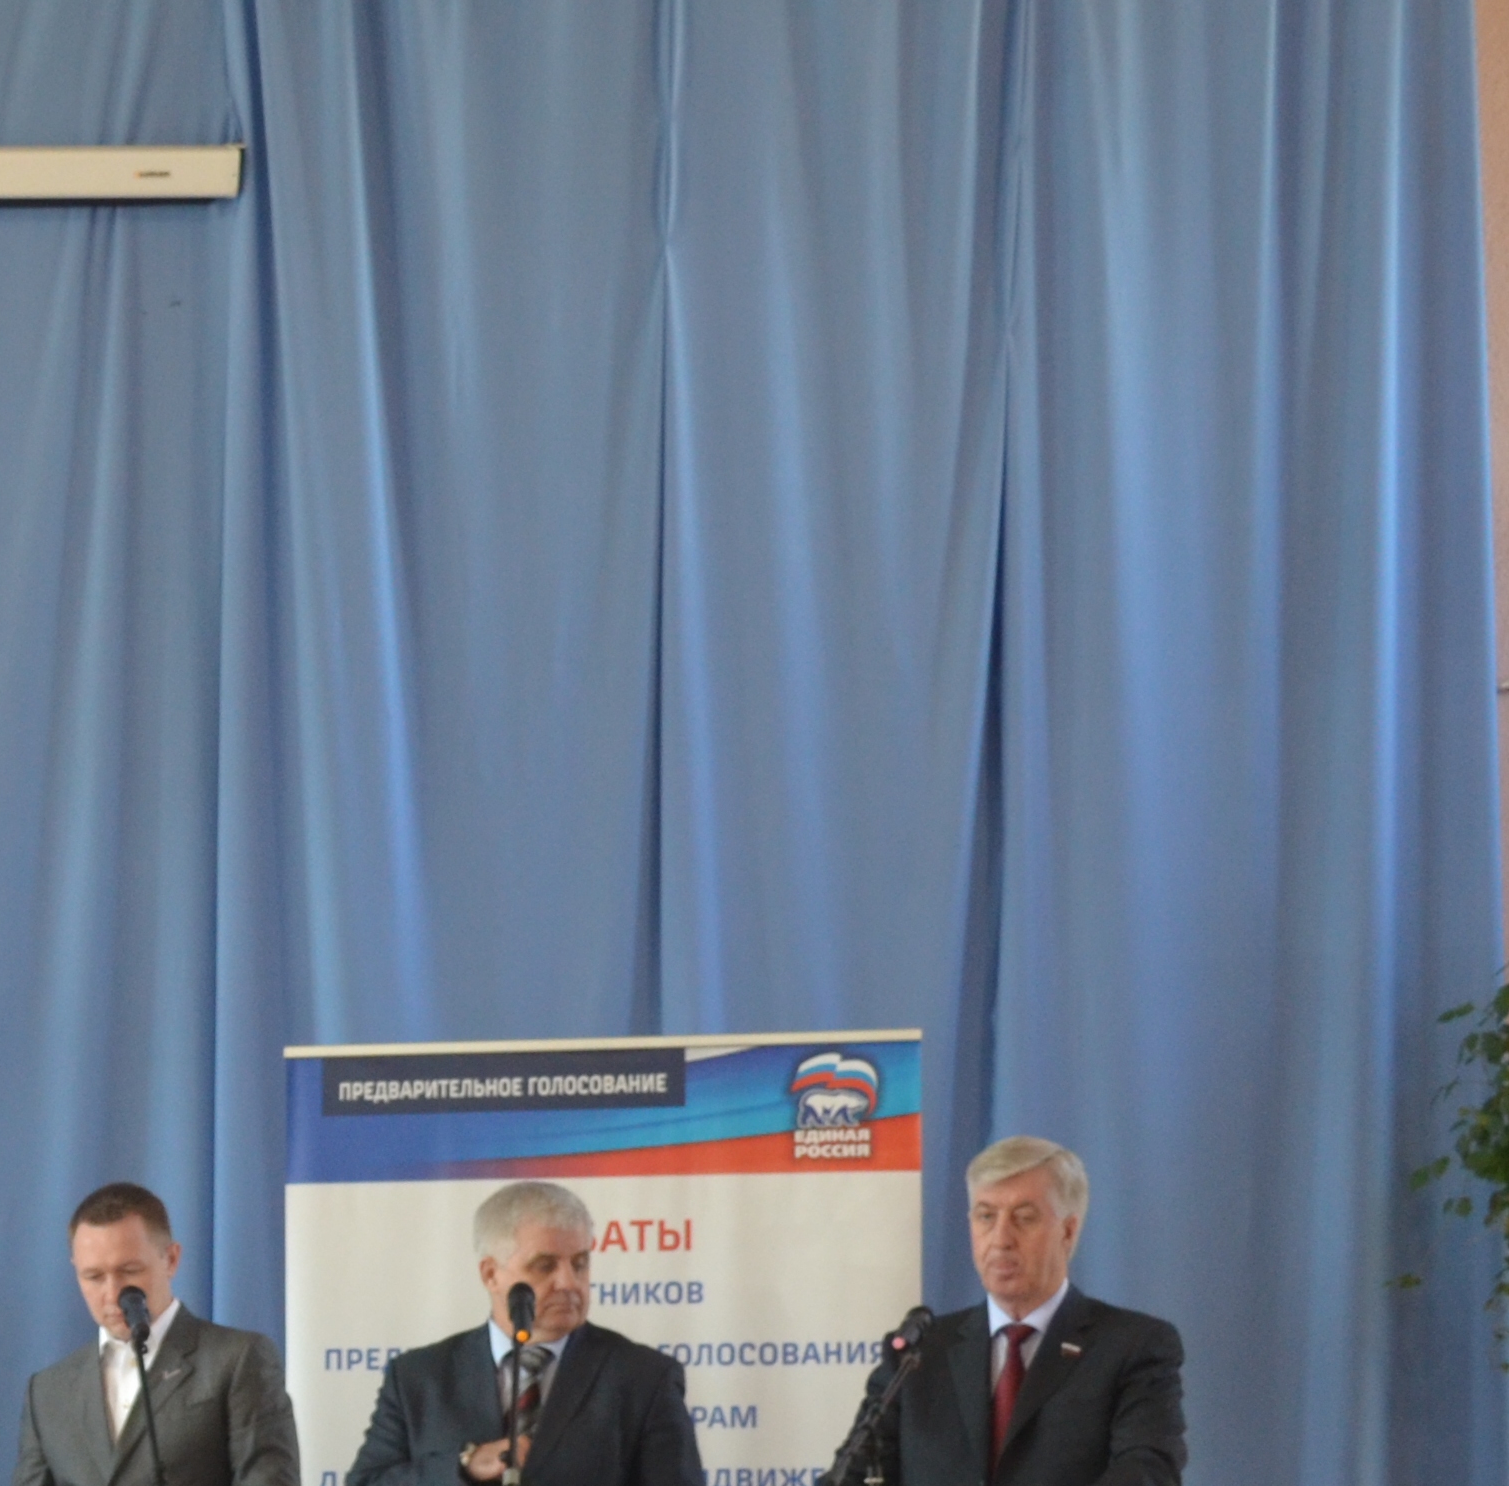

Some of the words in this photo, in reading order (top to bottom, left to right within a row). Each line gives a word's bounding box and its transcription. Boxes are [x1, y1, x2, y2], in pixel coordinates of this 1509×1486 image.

[338, 1076, 523, 1103] ПРЕДВАРИТЕЛЬНОЕ
[528, 1073, 667, 1096] ГОЛОСОВАНИЕ
[794, 1128, 870, 1144] ЕДИНАЯ
[794, 1144, 870, 1159] РОССИЯ
